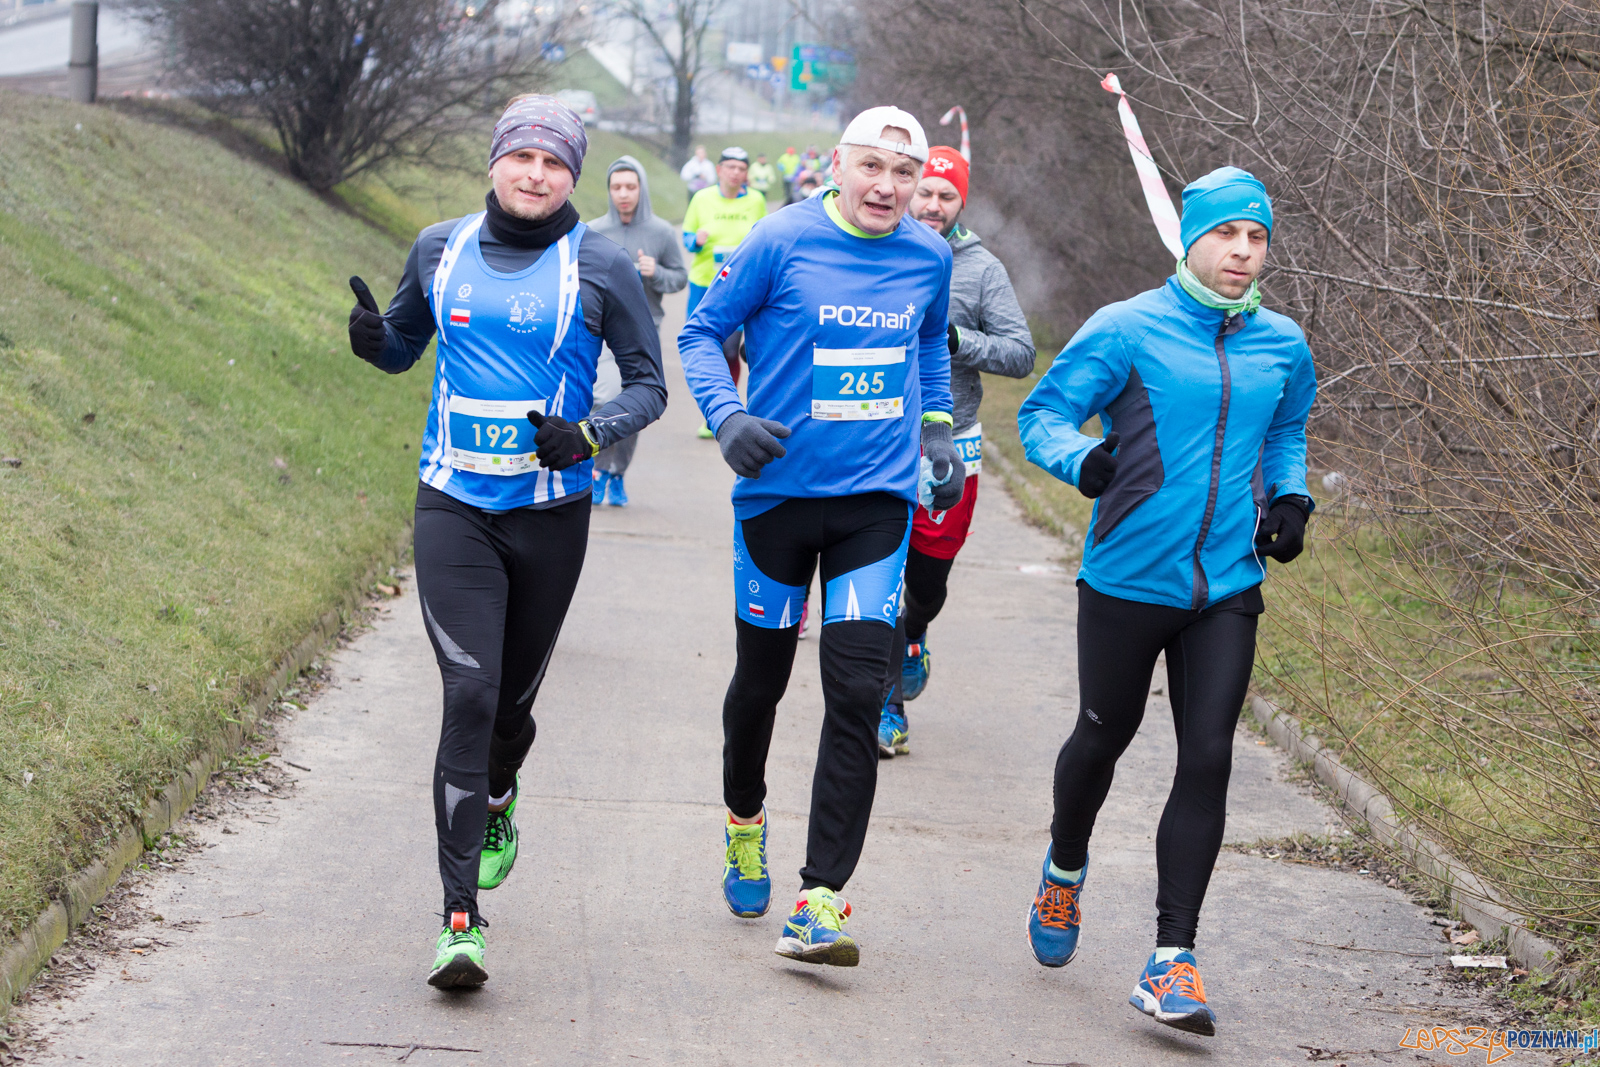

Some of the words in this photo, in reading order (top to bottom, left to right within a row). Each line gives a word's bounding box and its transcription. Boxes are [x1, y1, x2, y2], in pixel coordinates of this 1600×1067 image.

[839, 371, 885, 395] 265
[472, 423, 518, 448] 192
[956, 440, 981, 459] 185
